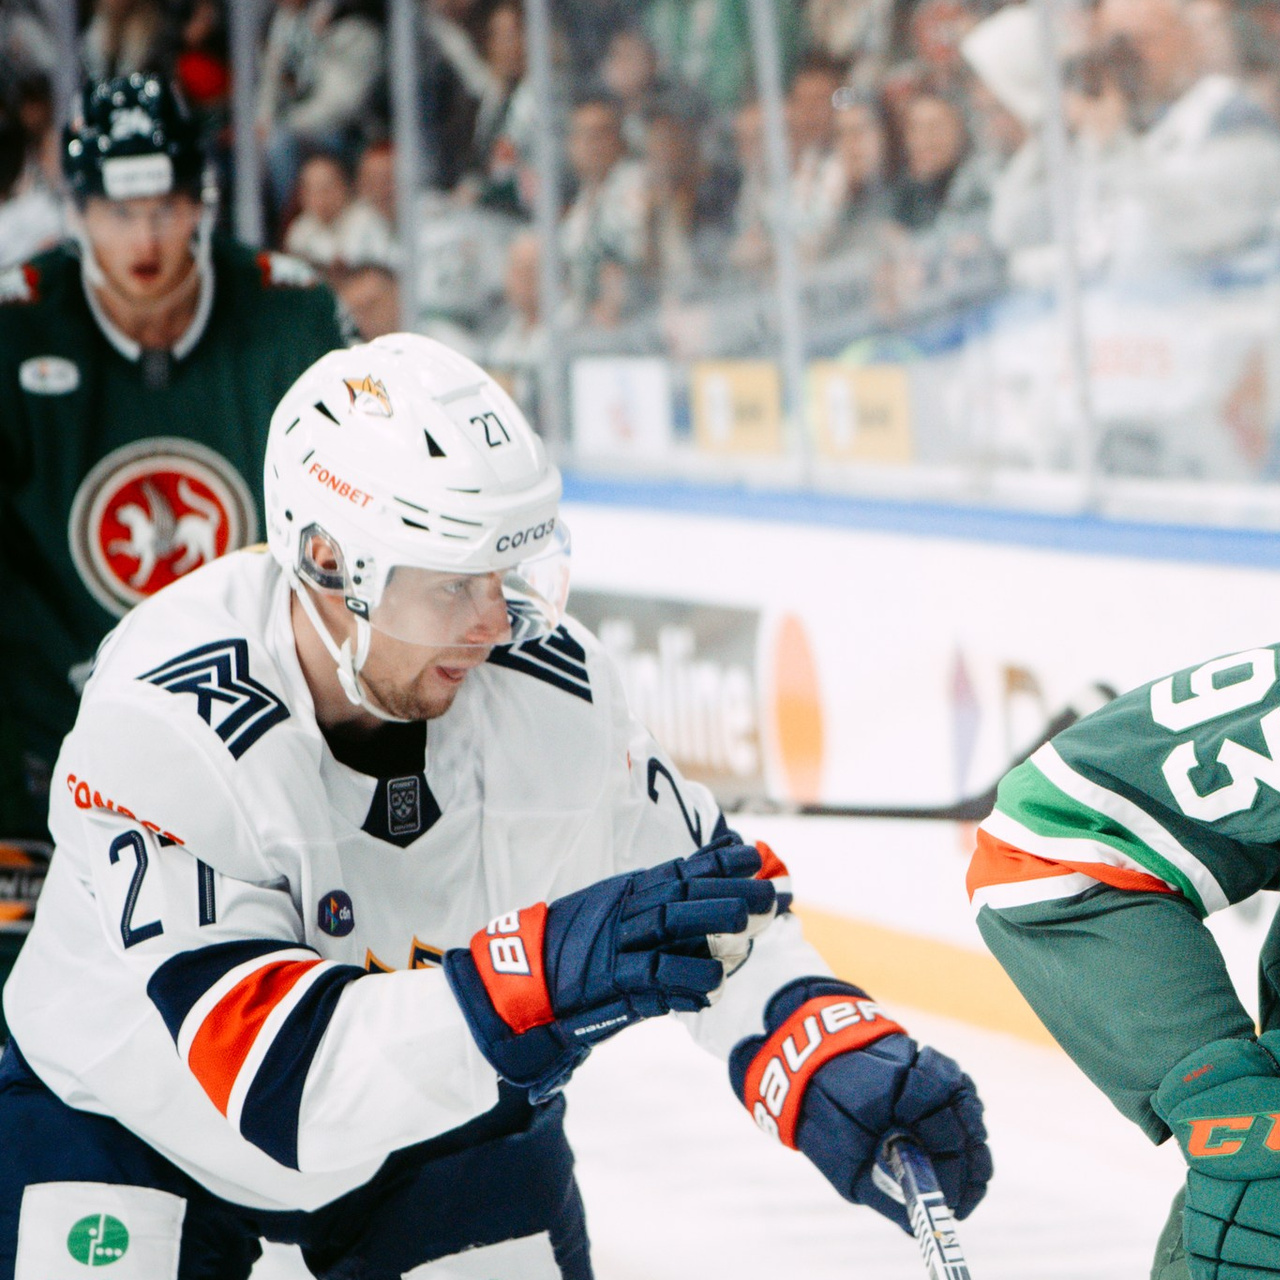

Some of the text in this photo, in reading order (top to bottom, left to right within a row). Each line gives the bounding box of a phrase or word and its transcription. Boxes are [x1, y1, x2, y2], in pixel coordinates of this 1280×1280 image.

[470, 411, 511, 447] 27
[309, 463, 374, 508] FONBET
[495, 518, 555, 553] согаз
